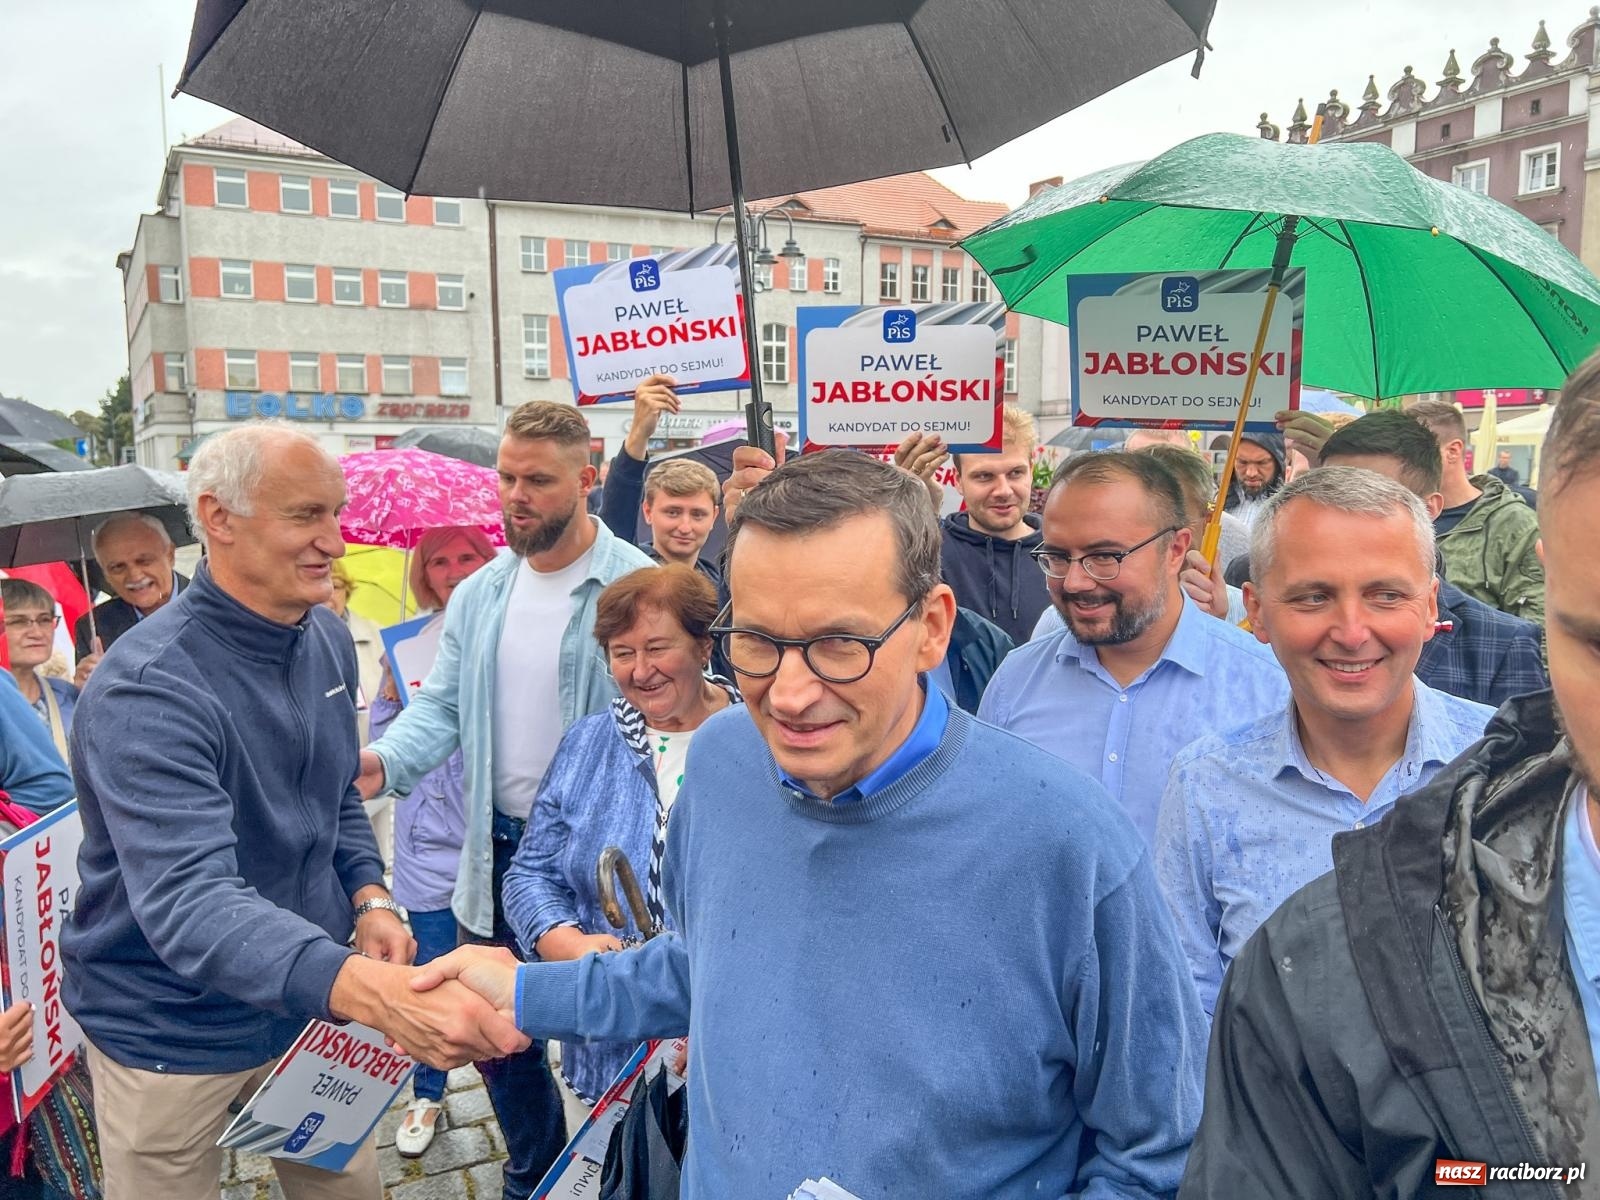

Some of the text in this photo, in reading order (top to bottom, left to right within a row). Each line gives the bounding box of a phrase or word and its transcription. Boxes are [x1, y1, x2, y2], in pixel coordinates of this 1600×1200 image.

[615, 298, 689, 322] PAWEŁ
[576, 316, 737, 357] JABŁOŃSKI
[1137, 324, 1229, 342] PAWEŁ
[597, 358, 724, 383] KANDYDAT DO SEJMU!
[861, 354, 942, 371] PAWEŁ
[1084, 346, 1285, 375] JABŁOŃSKI
[811, 374, 990, 403] JABŁOŃSKI
[1103, 395, 1178, 406] KANDYDAT
[1182, 396, 1204, 407] DO
[829, 421, 970, 432] KANDYDAT DO SEJMU!
[14, 875, 30, 1000] KANDYDAT DO
[35, 836, 64, 1067] JABŁOŃSKI
[304, 1023, 411, 1085] JABŁOŃSKI
[311, 1073, 363, 1105] PAWEŁ
